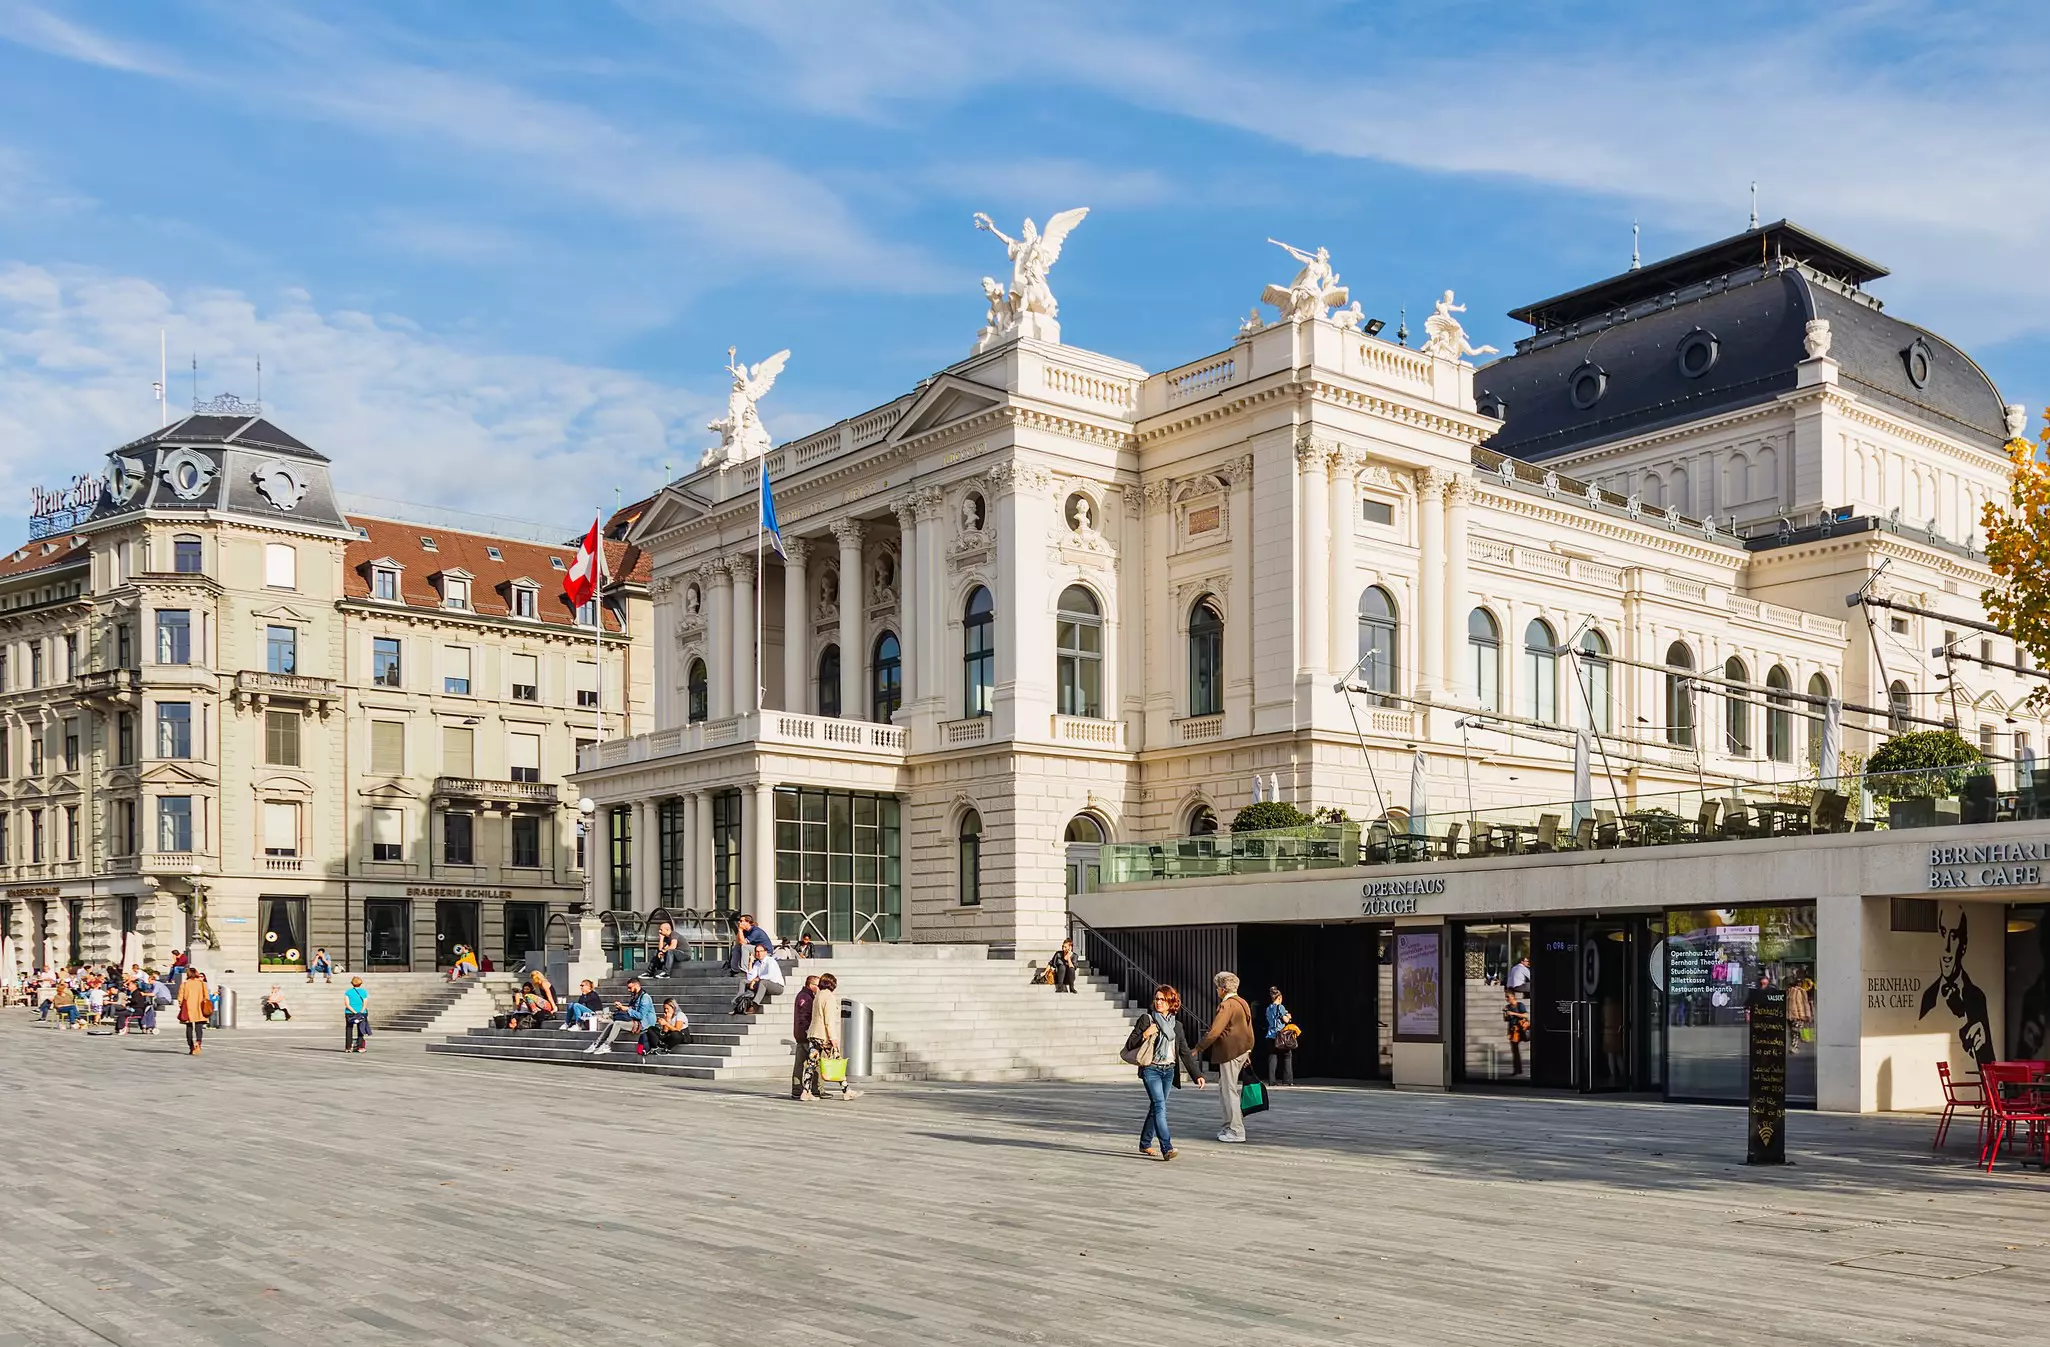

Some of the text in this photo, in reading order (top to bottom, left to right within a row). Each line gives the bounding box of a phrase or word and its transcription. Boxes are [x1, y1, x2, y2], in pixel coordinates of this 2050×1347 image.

[1929, 865, 2040, 889] BAR CAFE
[406, 887, 512, 899] BRASSERIE SCHILLER
[1362, 879, 1444, 897] OPERNHAUS
[1362, 897, 1417, 915] ZÜRICH
[1670, 950, 1703, 958] Opernhaus
[1700, 958, 1724, 966] Theater
[1670, 967, 1708, 975] Studiobühne
[1705, 985, 1733, 993] Belcanto
[1868, 977, 1921, 992] BERNHARD
[1868, 994, 1914, 1008] BAR CAFE
